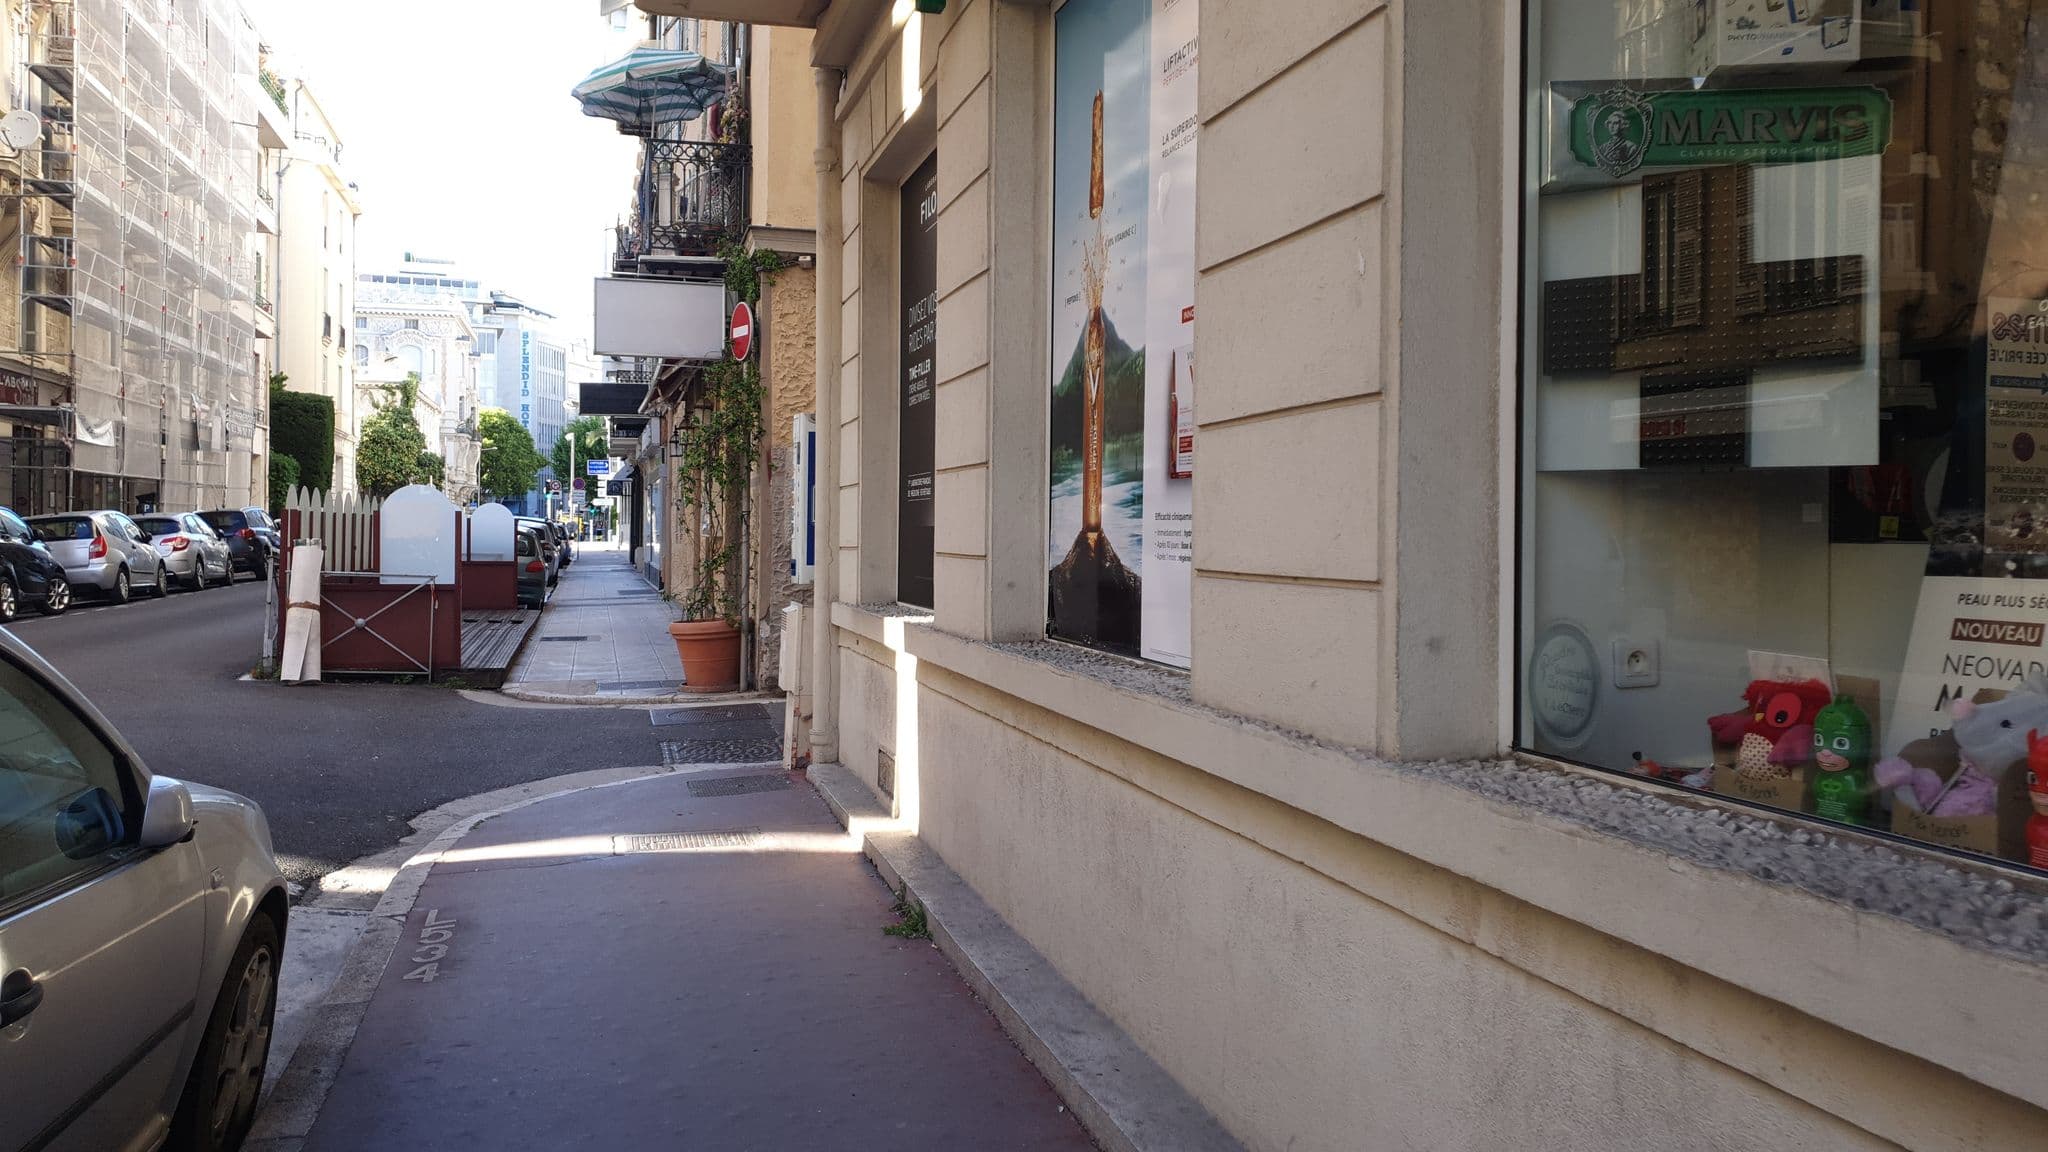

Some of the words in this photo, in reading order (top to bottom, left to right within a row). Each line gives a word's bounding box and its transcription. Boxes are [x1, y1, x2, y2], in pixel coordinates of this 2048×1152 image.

[1657, 103, 1869, 146] MARVIS
[1679, 149, 1737, 158] CLASSIC
[520, 331, 530, 398] SPLENDID
[1957, 593, 1991, 606] PEAU
[1993, 594, 2025, 608] PLUS
[1954, 621, 2041, 643] NOUVEAU
[1942, 653, 2048, 683] NEOVAD
